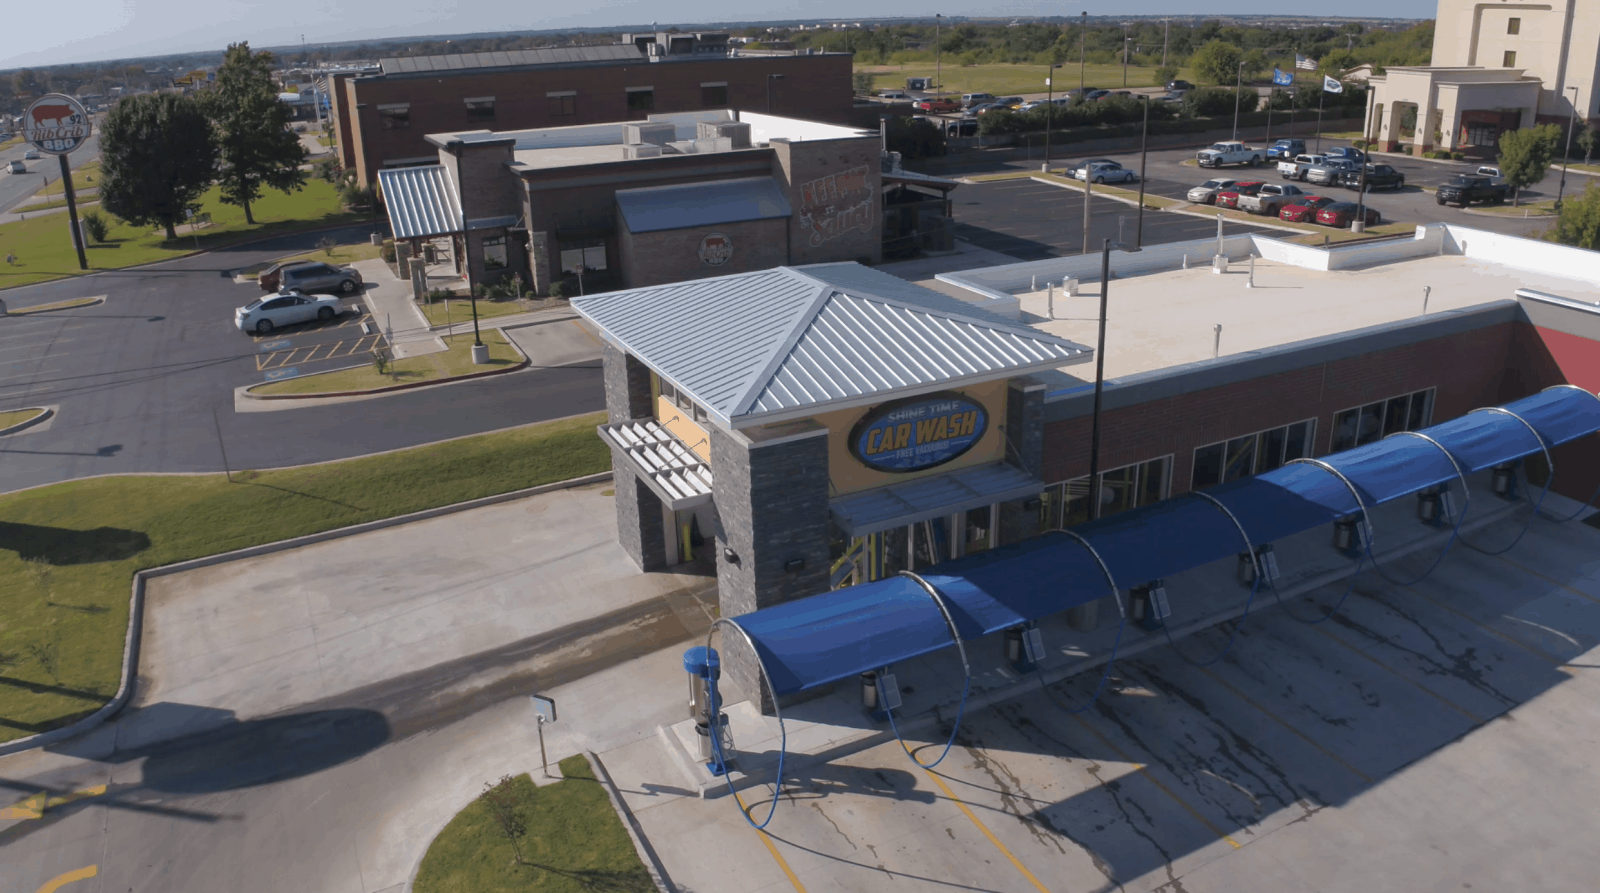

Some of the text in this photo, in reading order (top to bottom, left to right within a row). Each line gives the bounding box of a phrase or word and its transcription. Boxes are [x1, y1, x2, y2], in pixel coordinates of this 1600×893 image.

[69, 114, 82, 125] 92
[888, 400, 960, 423] SHINE TIME
[866, 411, 977, 455] CAR WASH
[896, 447, 914, 460] FREE
